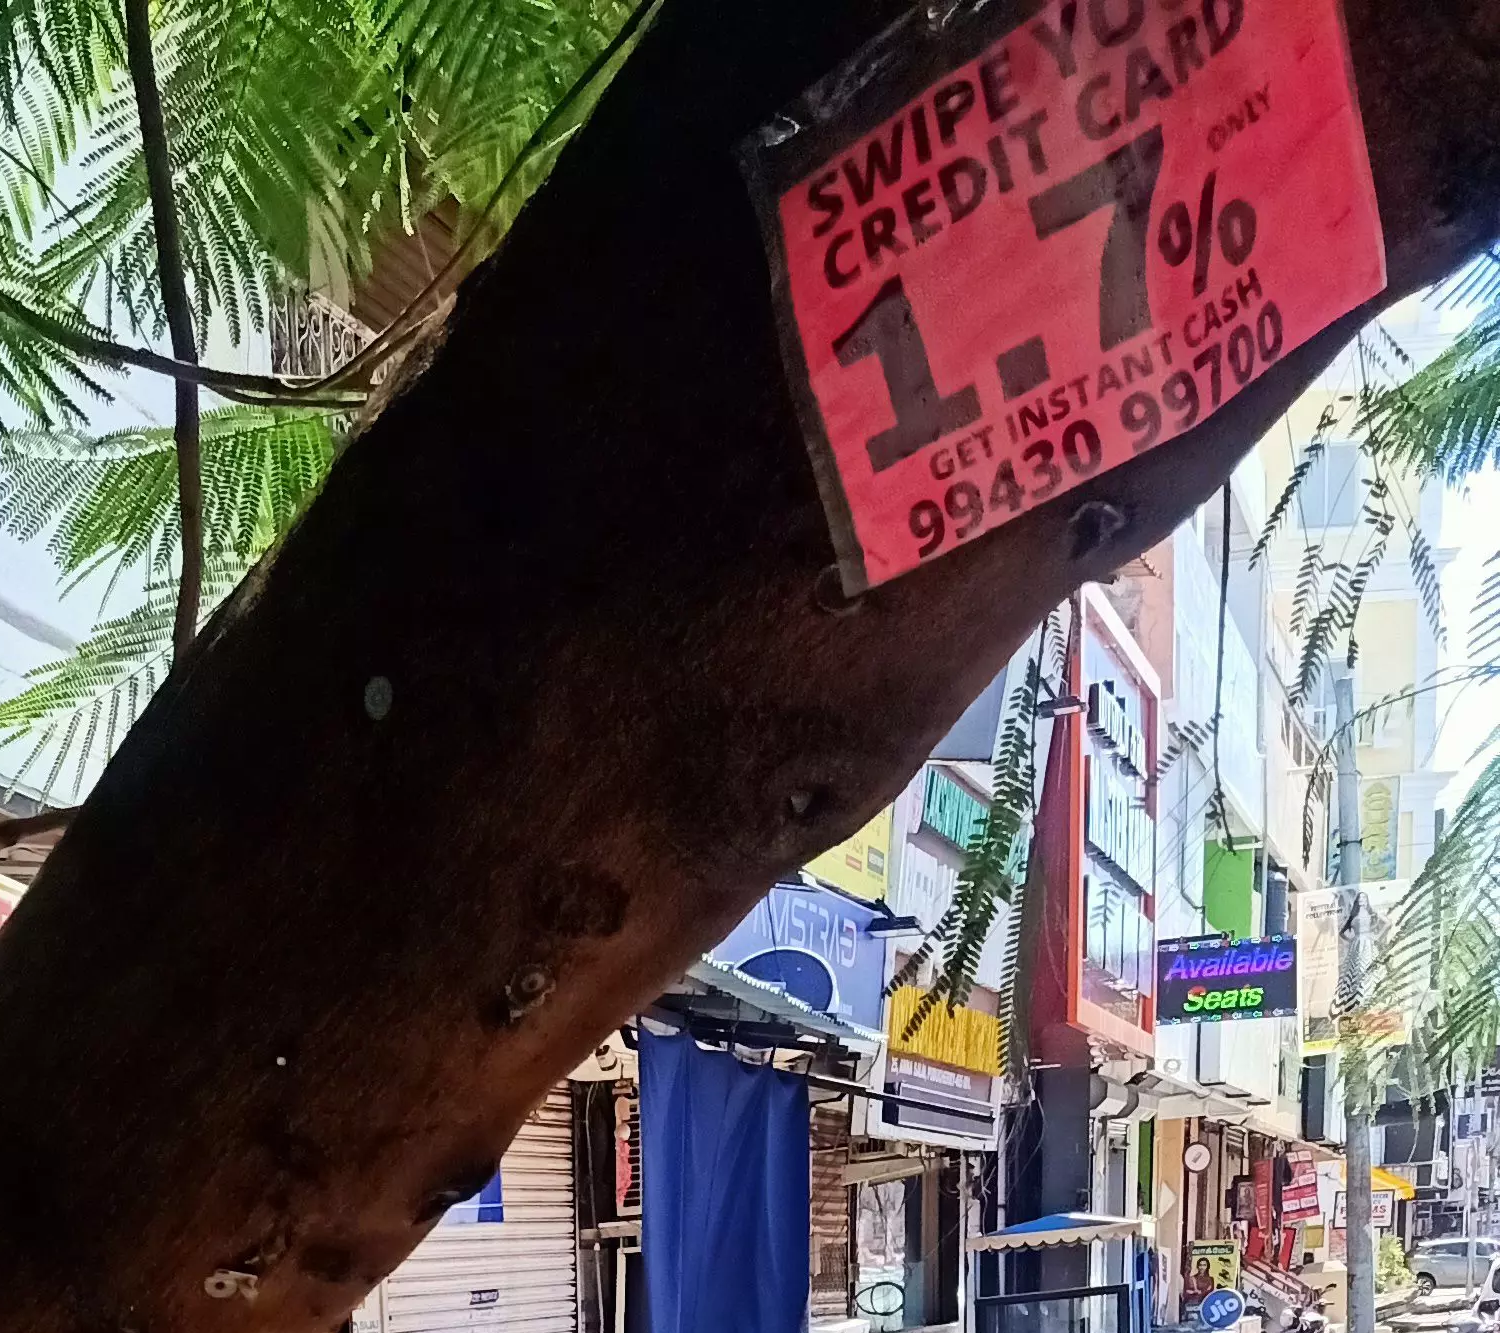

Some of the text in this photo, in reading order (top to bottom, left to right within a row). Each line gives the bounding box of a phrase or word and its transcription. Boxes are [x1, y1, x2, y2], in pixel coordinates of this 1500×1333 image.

[806, 47, 1021, 239] SWIPE
[822, 0, 1246, 290] CREDIT CARD
[1206, 84, 1273, 153] ONLY
[908, 300, 1284, 559] 99430 99700
[929, 267, 1263, 481] GET INSTANT CASH
[1163, 945, 1294, 983] Available
[1183, 984, 1264, 1012] Seats
[1209, 1299, 1240, 1323] Jio
